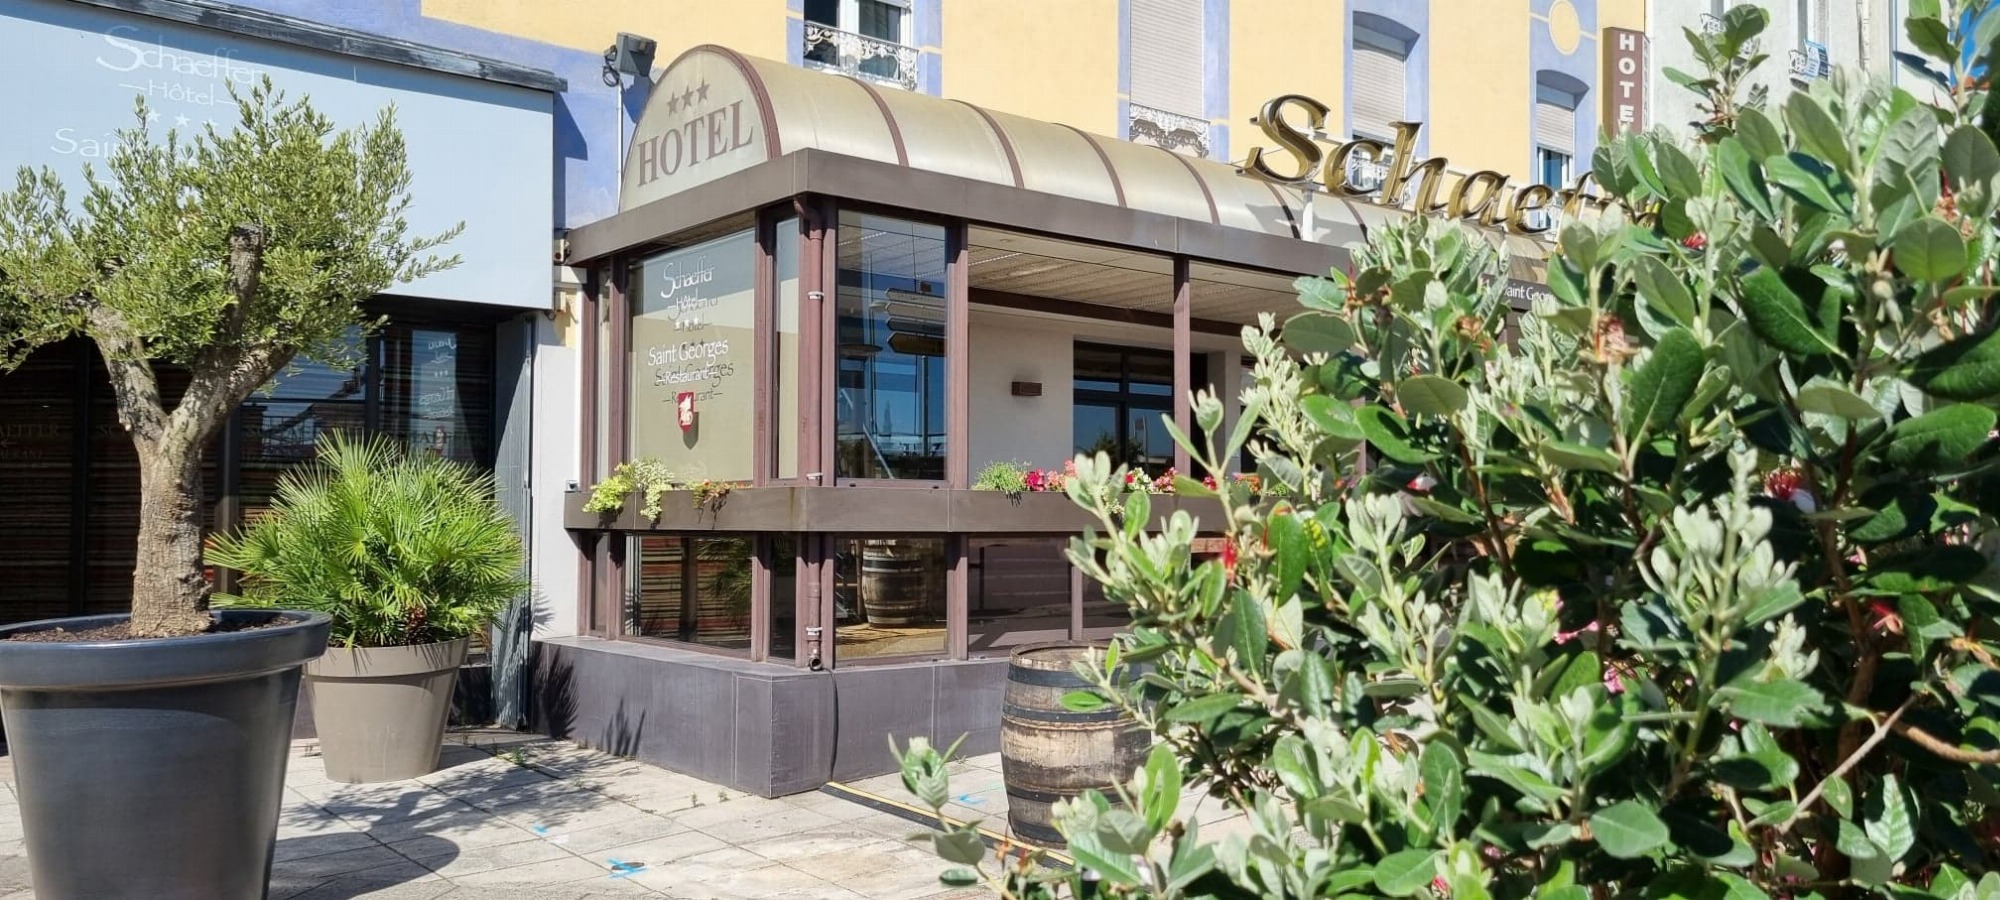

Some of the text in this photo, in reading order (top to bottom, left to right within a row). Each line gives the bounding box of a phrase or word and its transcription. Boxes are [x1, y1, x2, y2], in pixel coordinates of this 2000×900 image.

[95, 25, 264, 85] Schaeffer
[1618, 33, 1636, 123] HOTE
[148, 79, 214, 106] Hôtel
[637, 100, 754, 187] HOTEL
[1503, 282, 1525, 300] aint
[647, 339, 729, 367] Saint Georges
[665, 367, 709, 385] Restaurant
